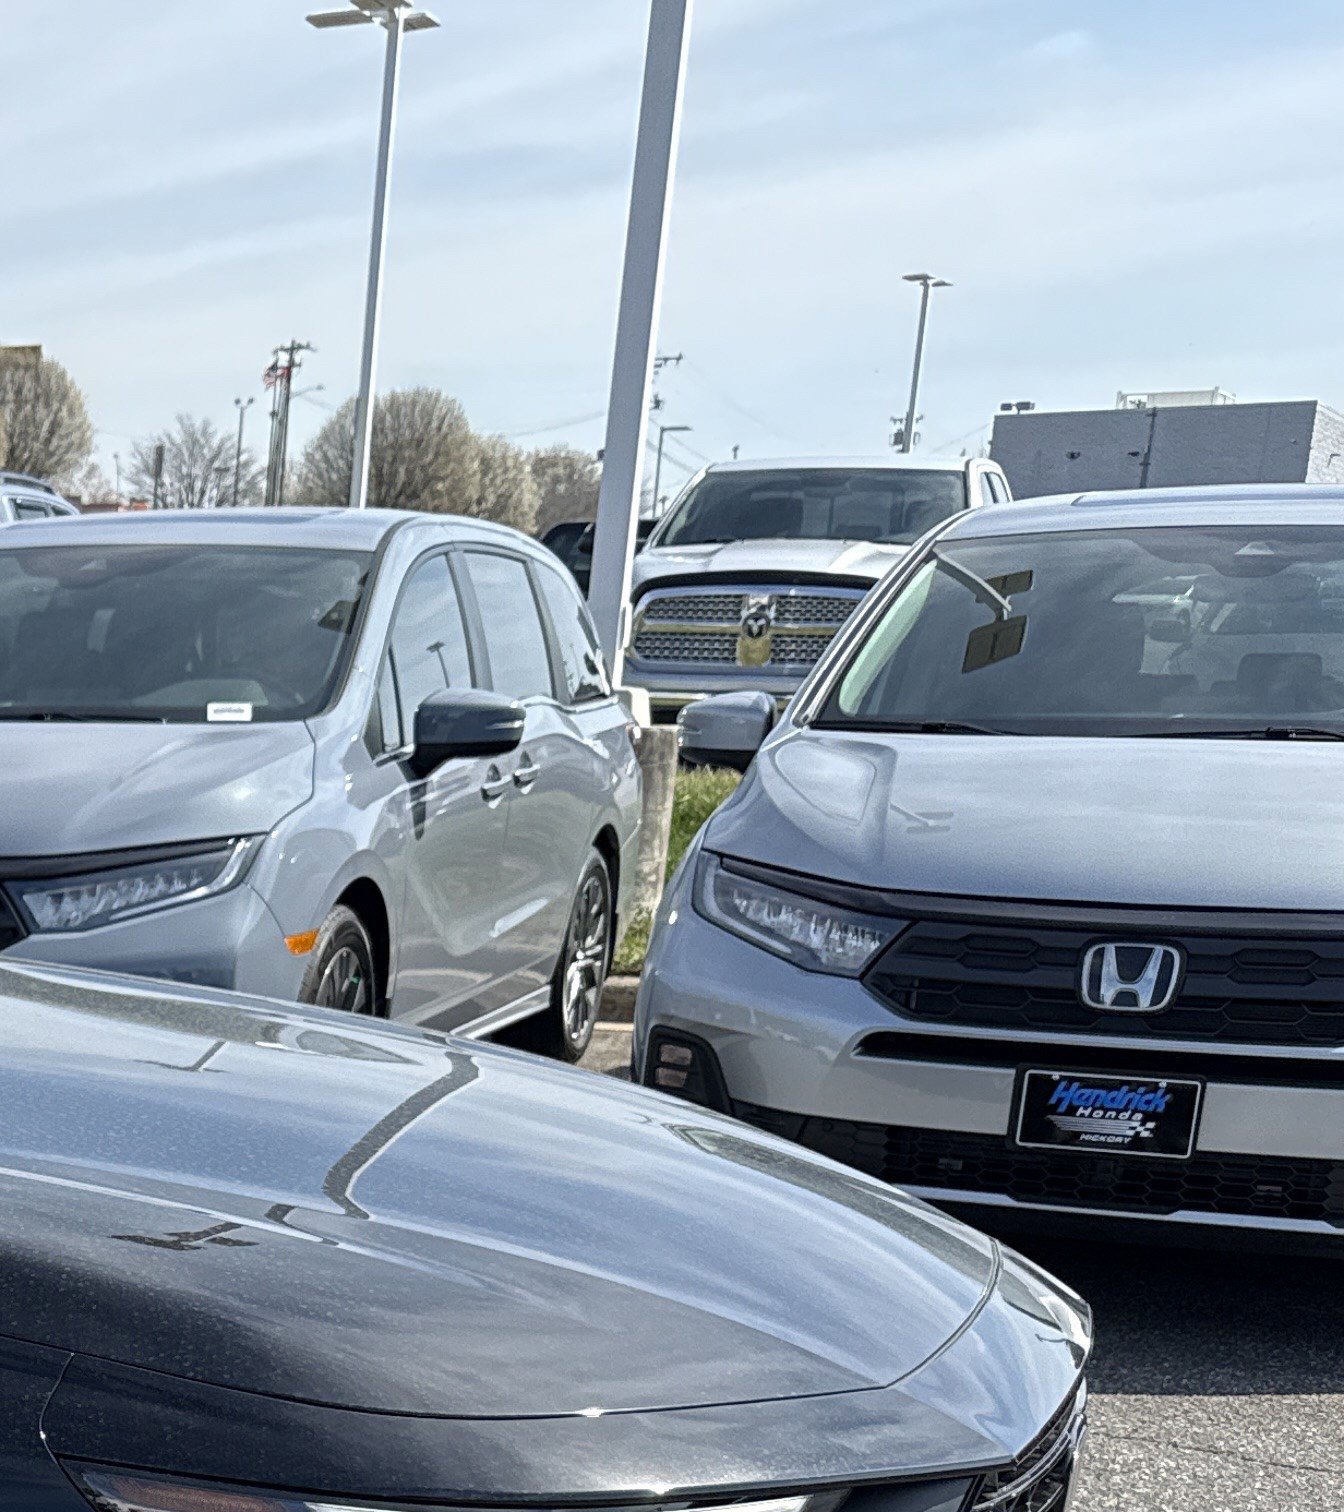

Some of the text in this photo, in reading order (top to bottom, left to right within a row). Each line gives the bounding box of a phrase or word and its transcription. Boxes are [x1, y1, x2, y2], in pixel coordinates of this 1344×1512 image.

[1049, 1080, 1173, 1113] Hendrick
[1075, 1106, 1144, 1121] Honda
[1079, 1133, 1132, 1144] HICKORY
